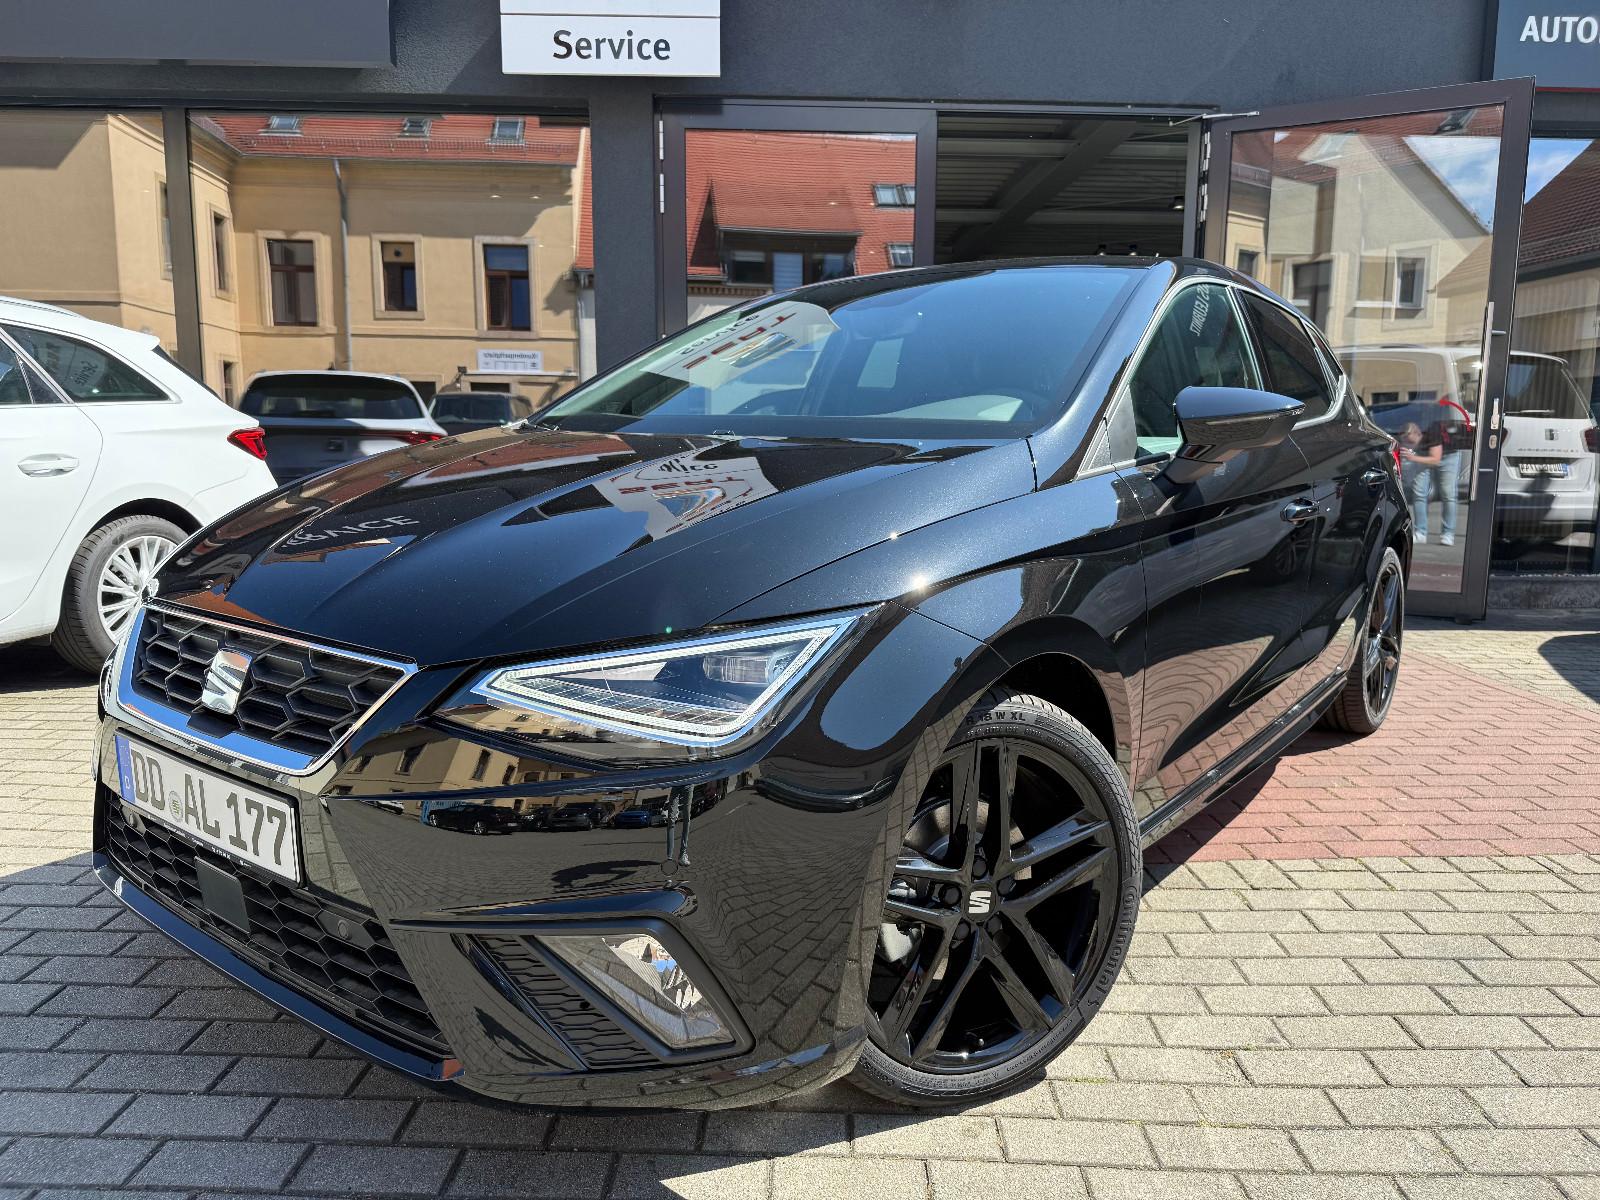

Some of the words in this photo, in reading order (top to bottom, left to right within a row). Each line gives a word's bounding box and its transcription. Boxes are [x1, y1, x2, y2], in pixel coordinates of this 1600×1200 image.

[1519, 15, 1600, 44] AUTO
[552, 29, 671, 61] Service
[994, 711, 1006, 720] W
[1010, 711, 1026, 721] XL
[131, 748, 166, 811] DD
[184, 772, 221, 839] AL
[226, 791, 287, 866] 177
